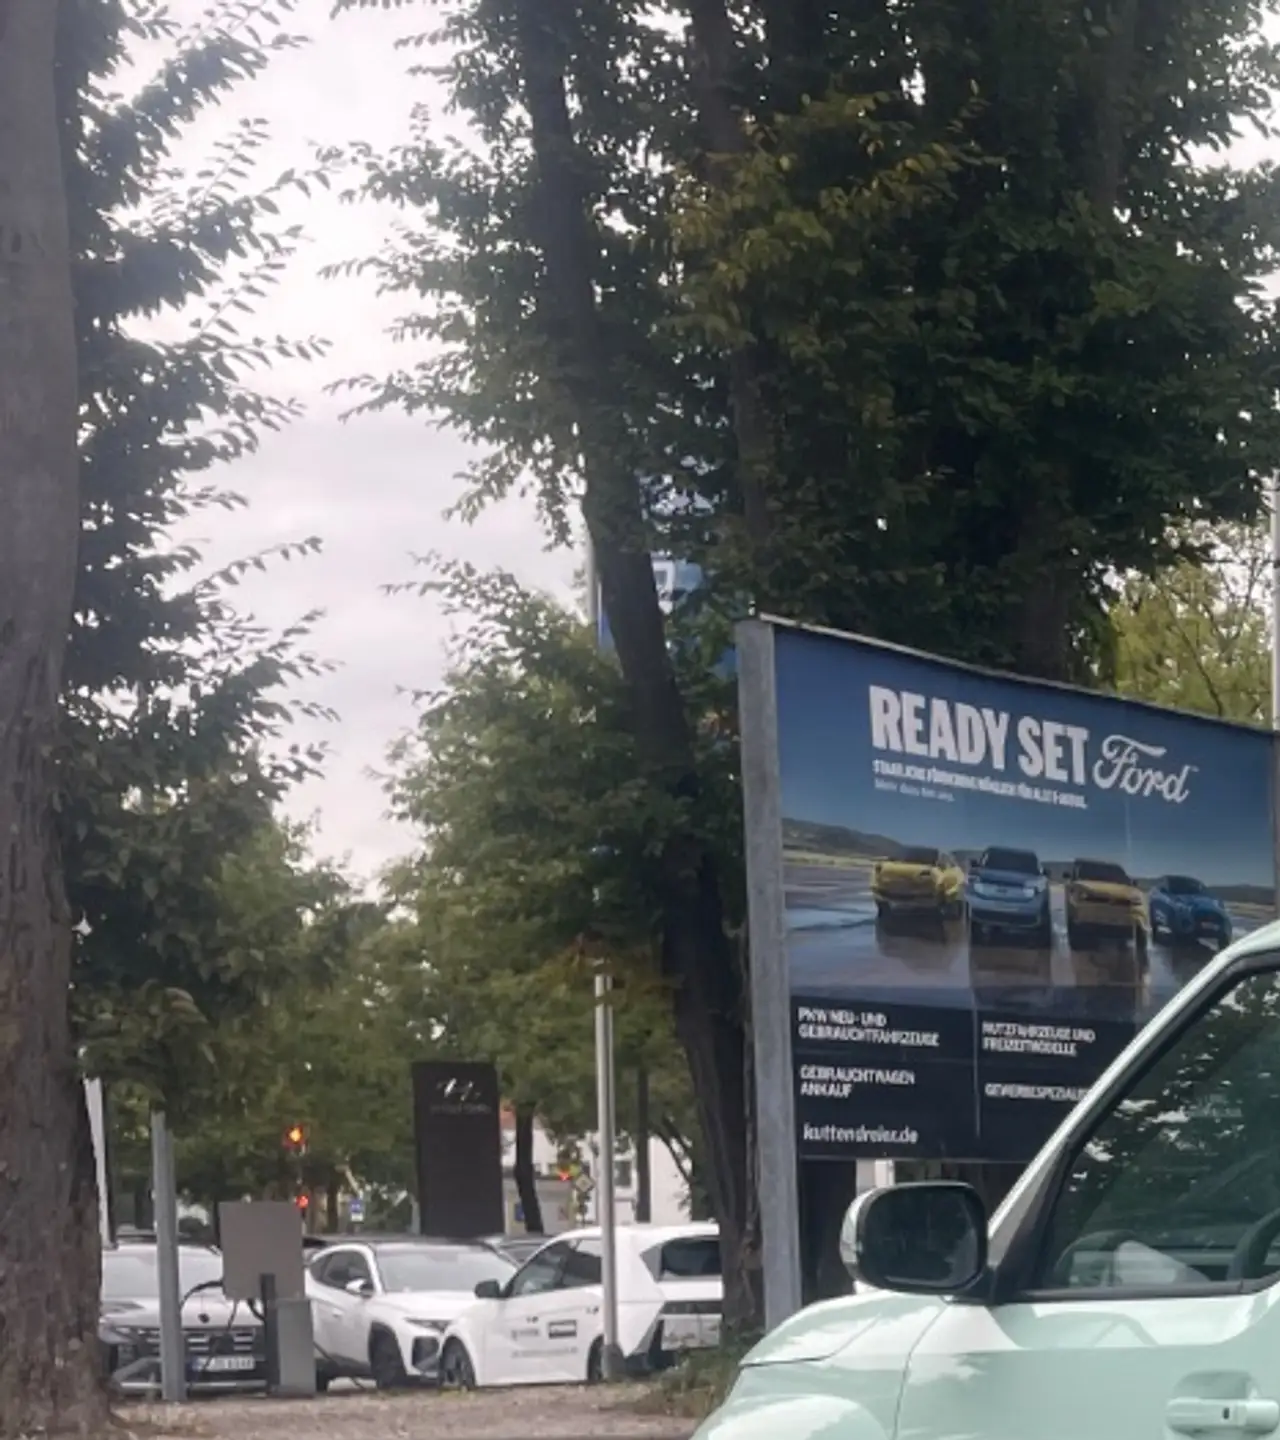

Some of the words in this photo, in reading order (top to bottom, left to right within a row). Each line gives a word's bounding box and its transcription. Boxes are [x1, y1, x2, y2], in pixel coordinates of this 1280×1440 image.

[869, 685, 1010, 770] READY
[1017, 716, 1089, 785] SET
[1093, 734, 1190, 803] Ford
[861, 1012, 887, 1027] UND
[798, 1023, 940, 1047] GEBRAUCHTFAHRZEUGE
[800, 1064, 916, 1085] GEBRAUCHTWAGEN
[800, 1081, 853, 1097] ANKAUF
[803, 1121, 918, 1145] kuttendreier.de
